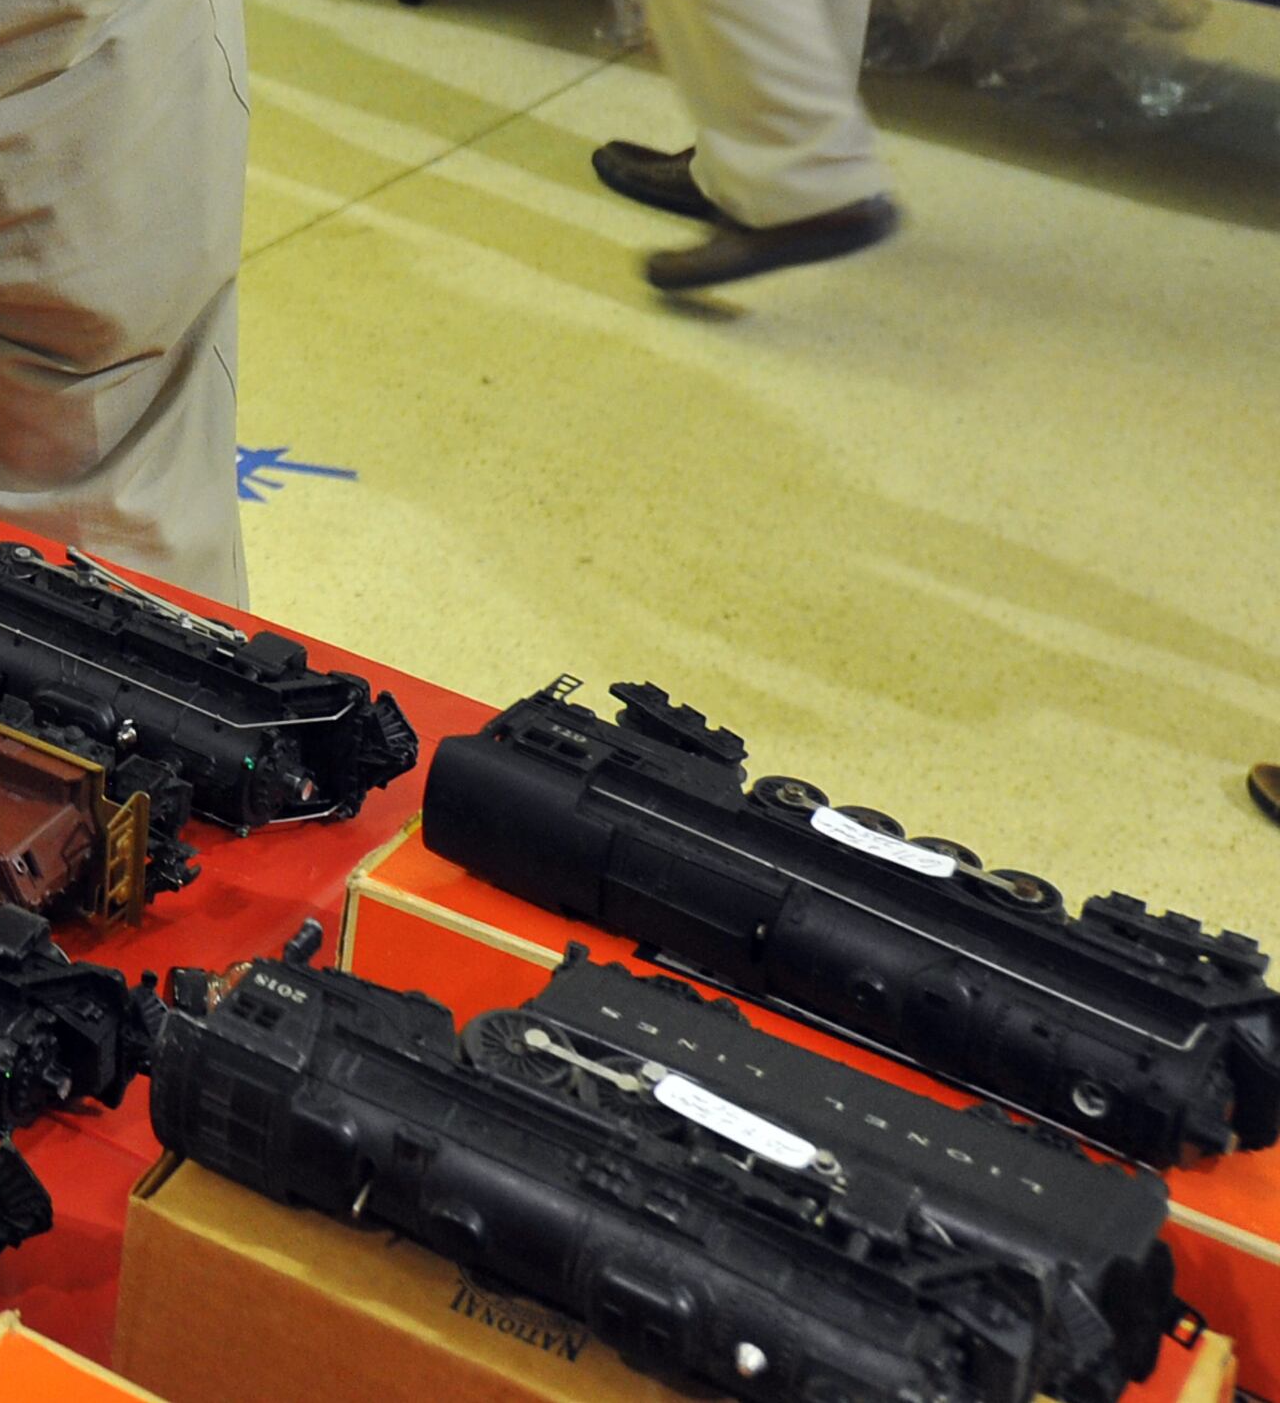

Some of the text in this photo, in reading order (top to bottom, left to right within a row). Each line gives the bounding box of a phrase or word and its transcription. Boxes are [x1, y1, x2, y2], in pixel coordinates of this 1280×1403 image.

[252, 971, 309, 1005] 2018
[600, 1004, 766, 1079] LINES
[825, 1094, 1044, 1196] LIONEL
[449, 1277, 589, 1365] NATIONAL
